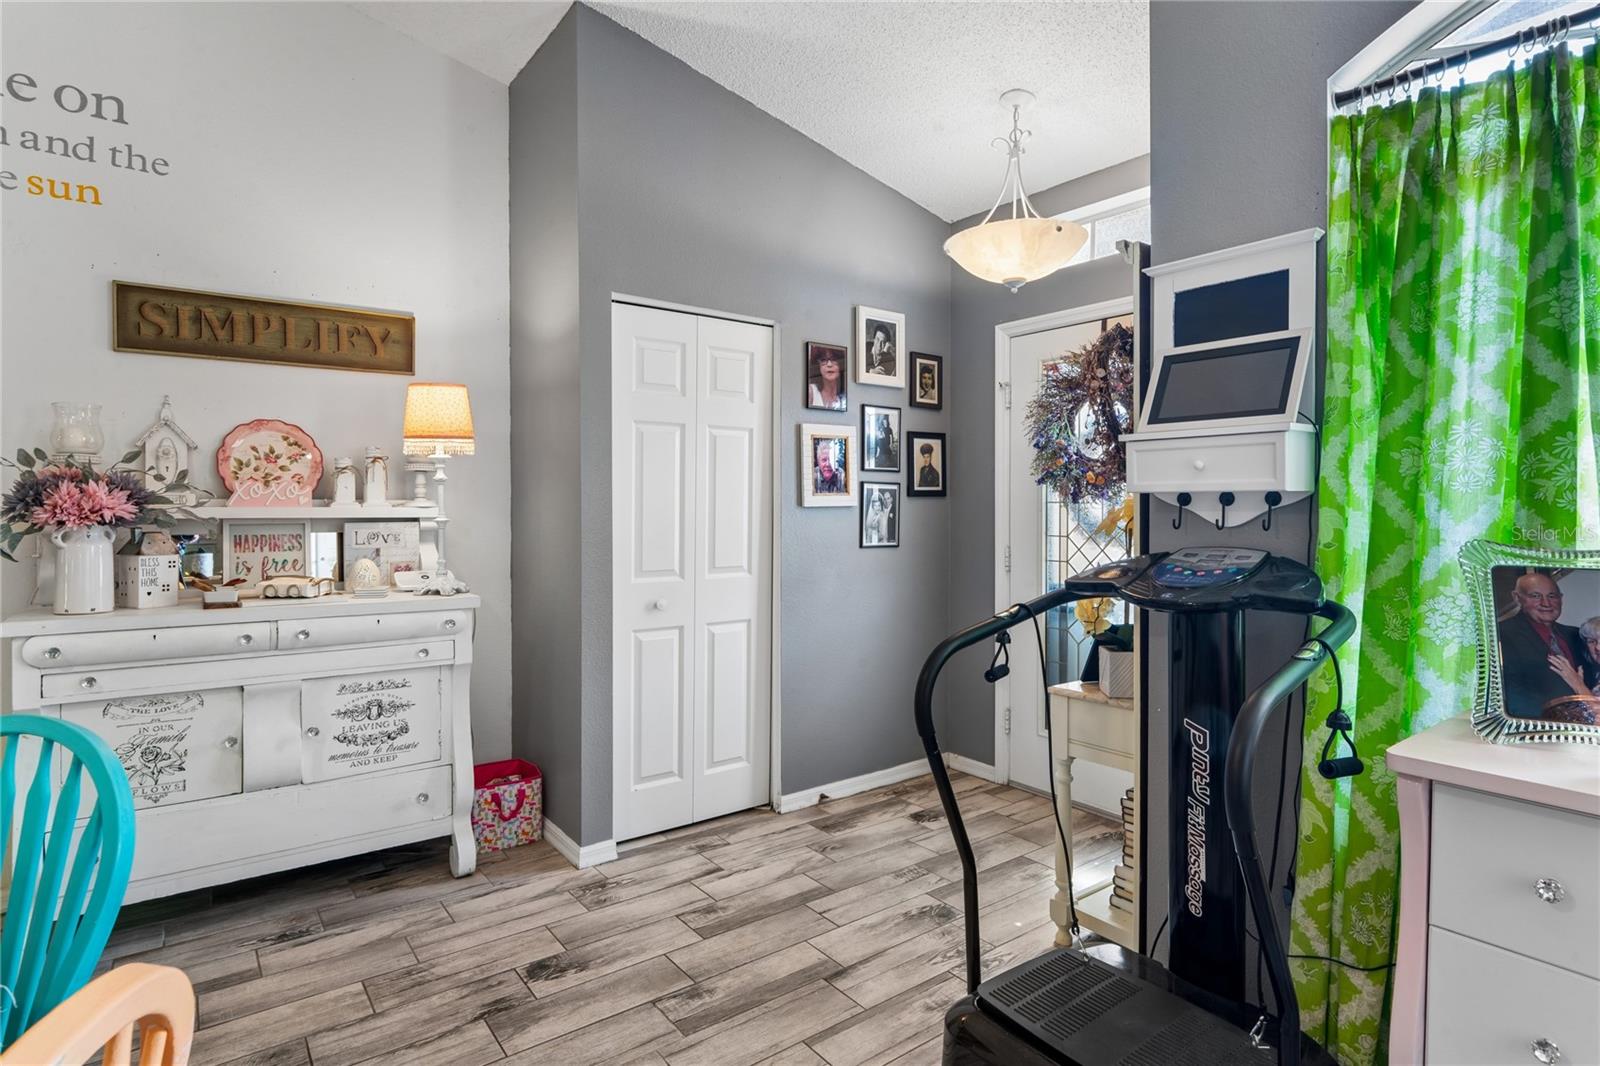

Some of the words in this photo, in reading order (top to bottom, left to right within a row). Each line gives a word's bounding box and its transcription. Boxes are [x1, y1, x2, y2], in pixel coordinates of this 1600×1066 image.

[53, 84, 129, 125] on
[19, 130, 97, 163] and
[108, 143, 170, 176] the
[26, 175, 103, 206] sun
[137, 301, 391, 358] SIMPLIFY
[233, 533, 303, 554] HAPPINESS
[140, 557, 160, 568] BLESS
[235, 556, 253, 576] is
[261, 555, 304, 581] free
[141, 567, 158, 577] THIS
[140, 577, 160, 588] HOME
[130, 706, 151, 715] THE
[154, 703, 180, 714] LOVE
[138, 726, 149, 735] IN
[152, 724, 175, 733] OUR
[341, 720, 391, 734] LEAVING
[350, 759, 371, 768] AND
[372, 754, 398, 765] KEEP
